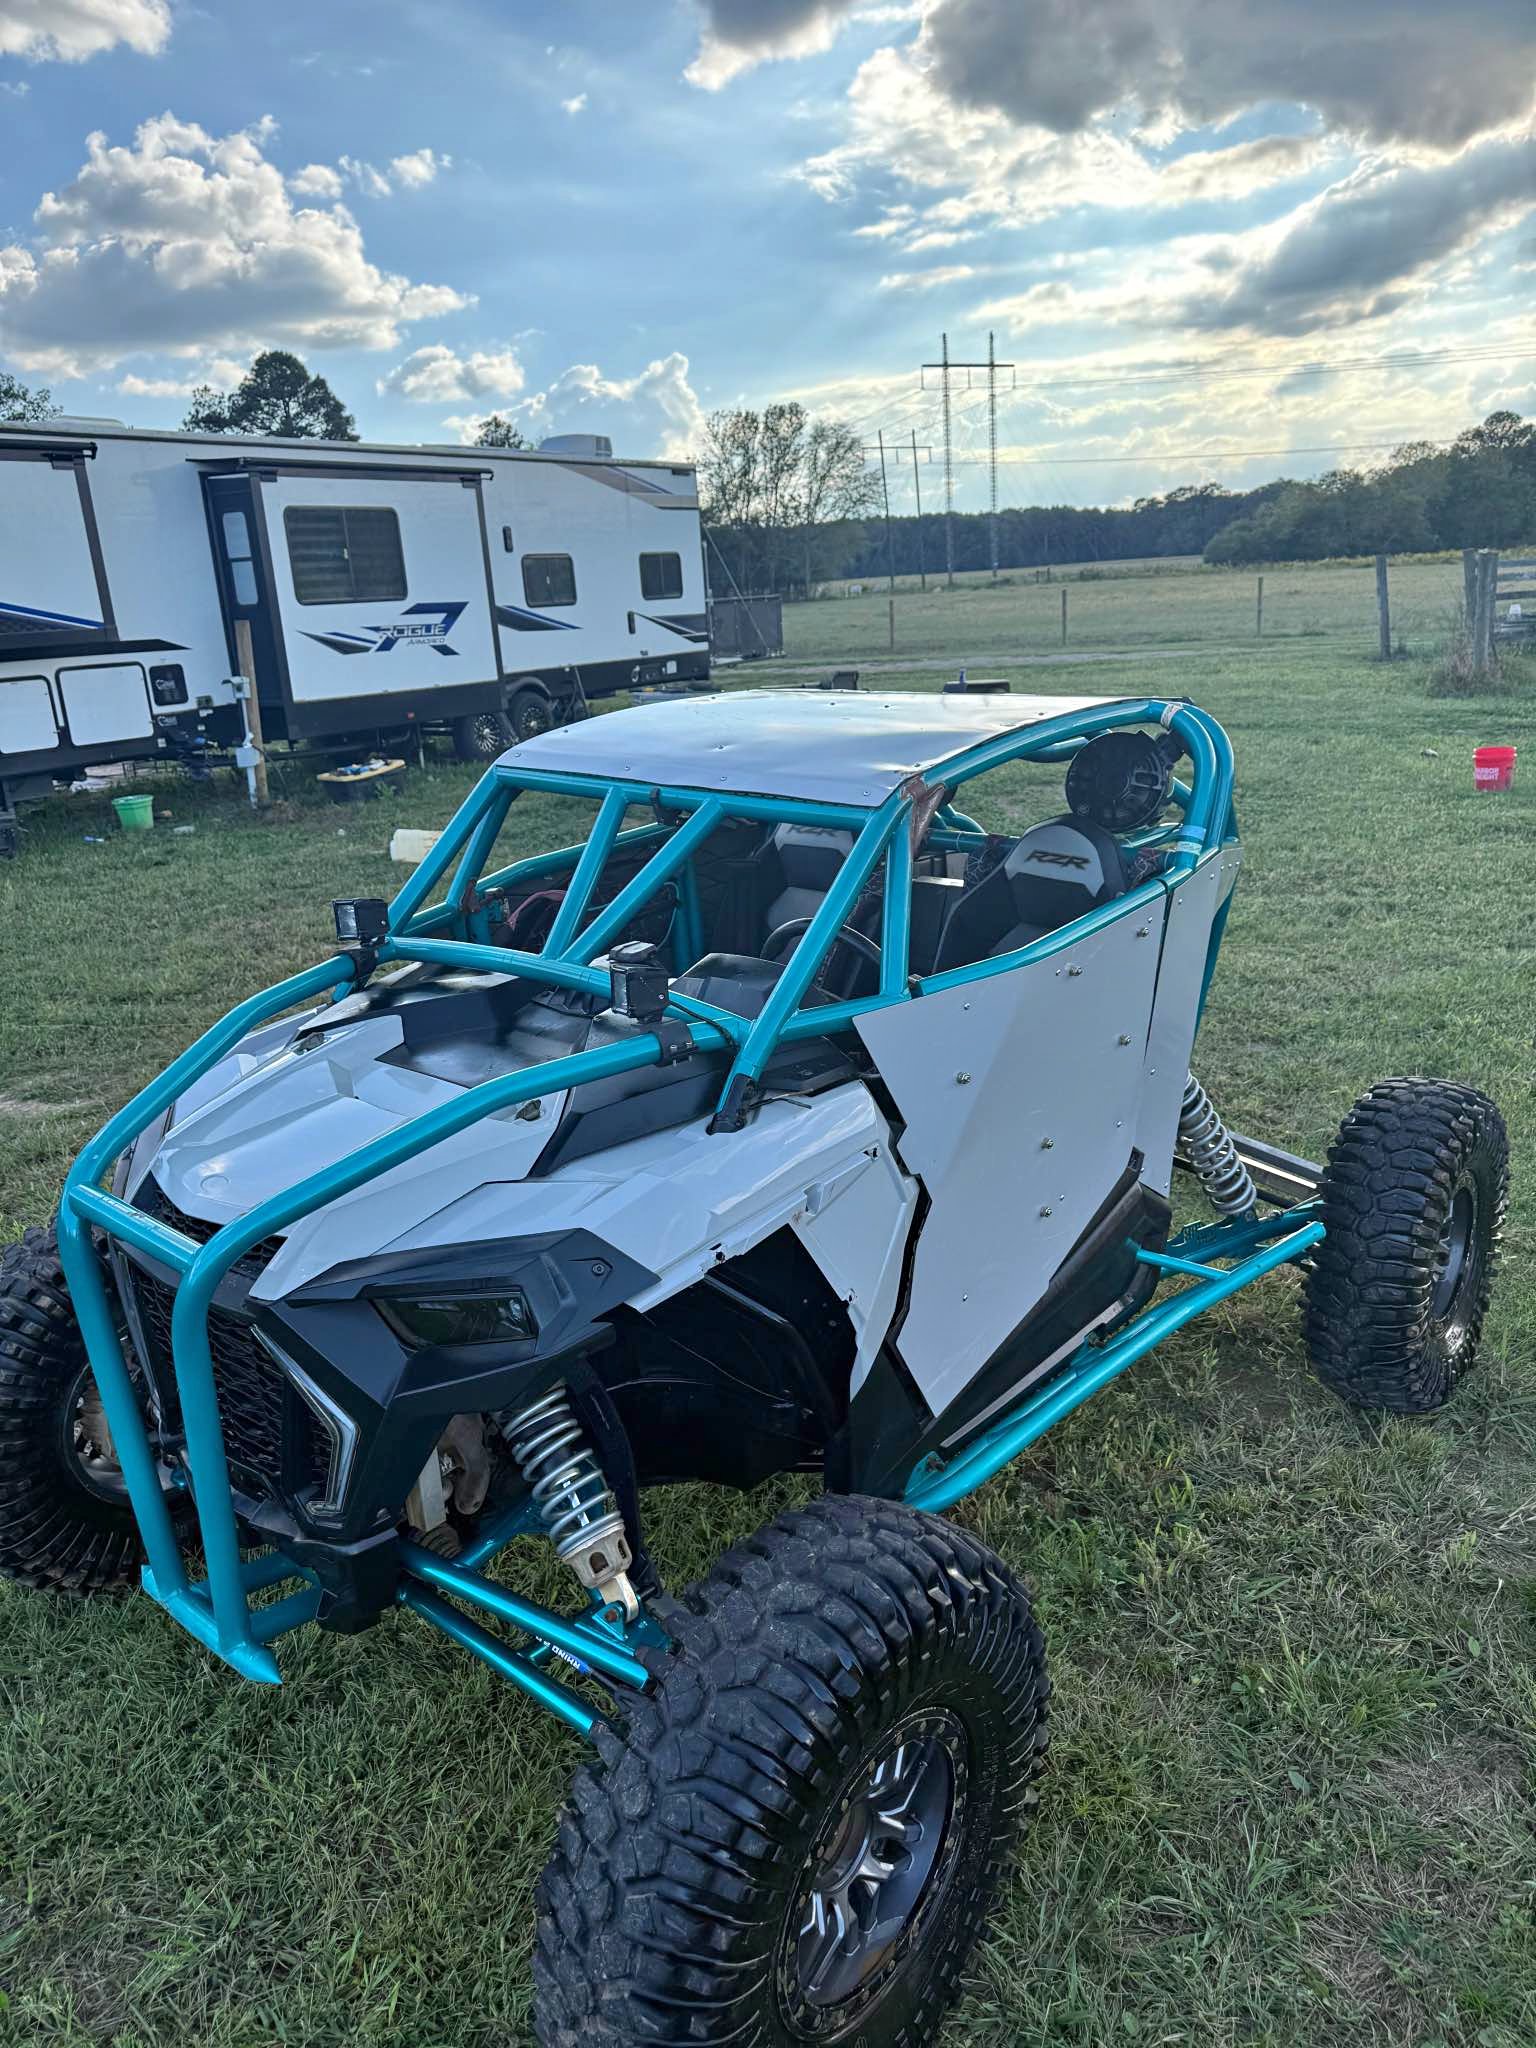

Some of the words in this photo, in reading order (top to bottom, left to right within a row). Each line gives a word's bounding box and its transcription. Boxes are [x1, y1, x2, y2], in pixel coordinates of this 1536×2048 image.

[379, 624, 446, 639] ROGUE
[1025, 849, 1091, 870] RZR
[551, 1644, 581, 1669] RHINO
